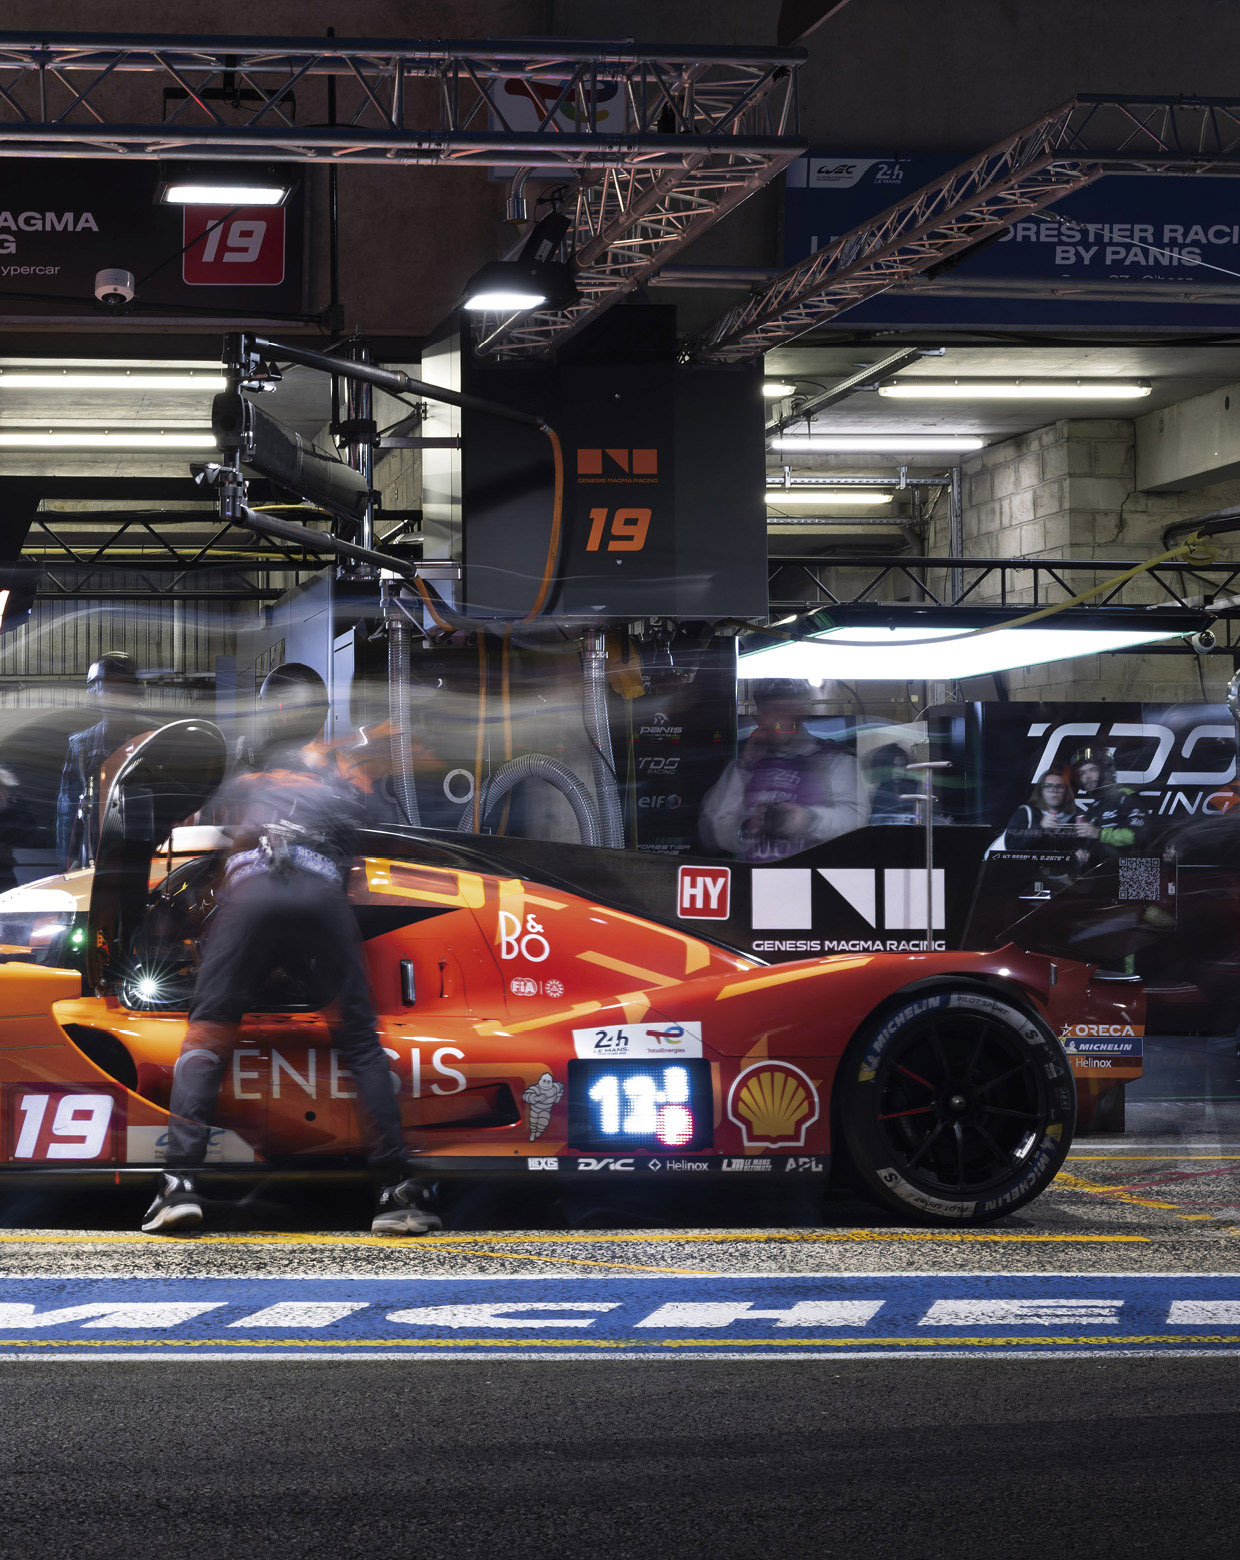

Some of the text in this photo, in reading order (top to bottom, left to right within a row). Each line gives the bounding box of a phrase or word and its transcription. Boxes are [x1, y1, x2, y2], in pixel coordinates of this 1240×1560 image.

[201, 219, 267, 262] 19
[1055, 246, 1203, 267] BY PANIS
[585, 507, 652, 551] 19
[637, 795, 666, 808] elf
[682, 876, 726, 910] HY
[752, 940, 946, 951] GENESIS MAGMA RACING
[511, 980, 536, 993] FIA
[956, 996, 1010, 1015] PILOT SPORT
[873, 995, 941, 1049] MICHELIN
[1075, 1024, 1135, 1037] ORECA
[594, 1029, 629, 1049] 24h
[1079, 1043, 1133, 1051] MICHELIN
[1076, 1057, 1112, 1068] Helinox
[14, 1094, 115, 1159] 19
[527, 1157, 559, 1170] HEXIS
[666, 1159, 709, 1172] Helinox
[985, 1152, 1050, 1212] MICHELIN
